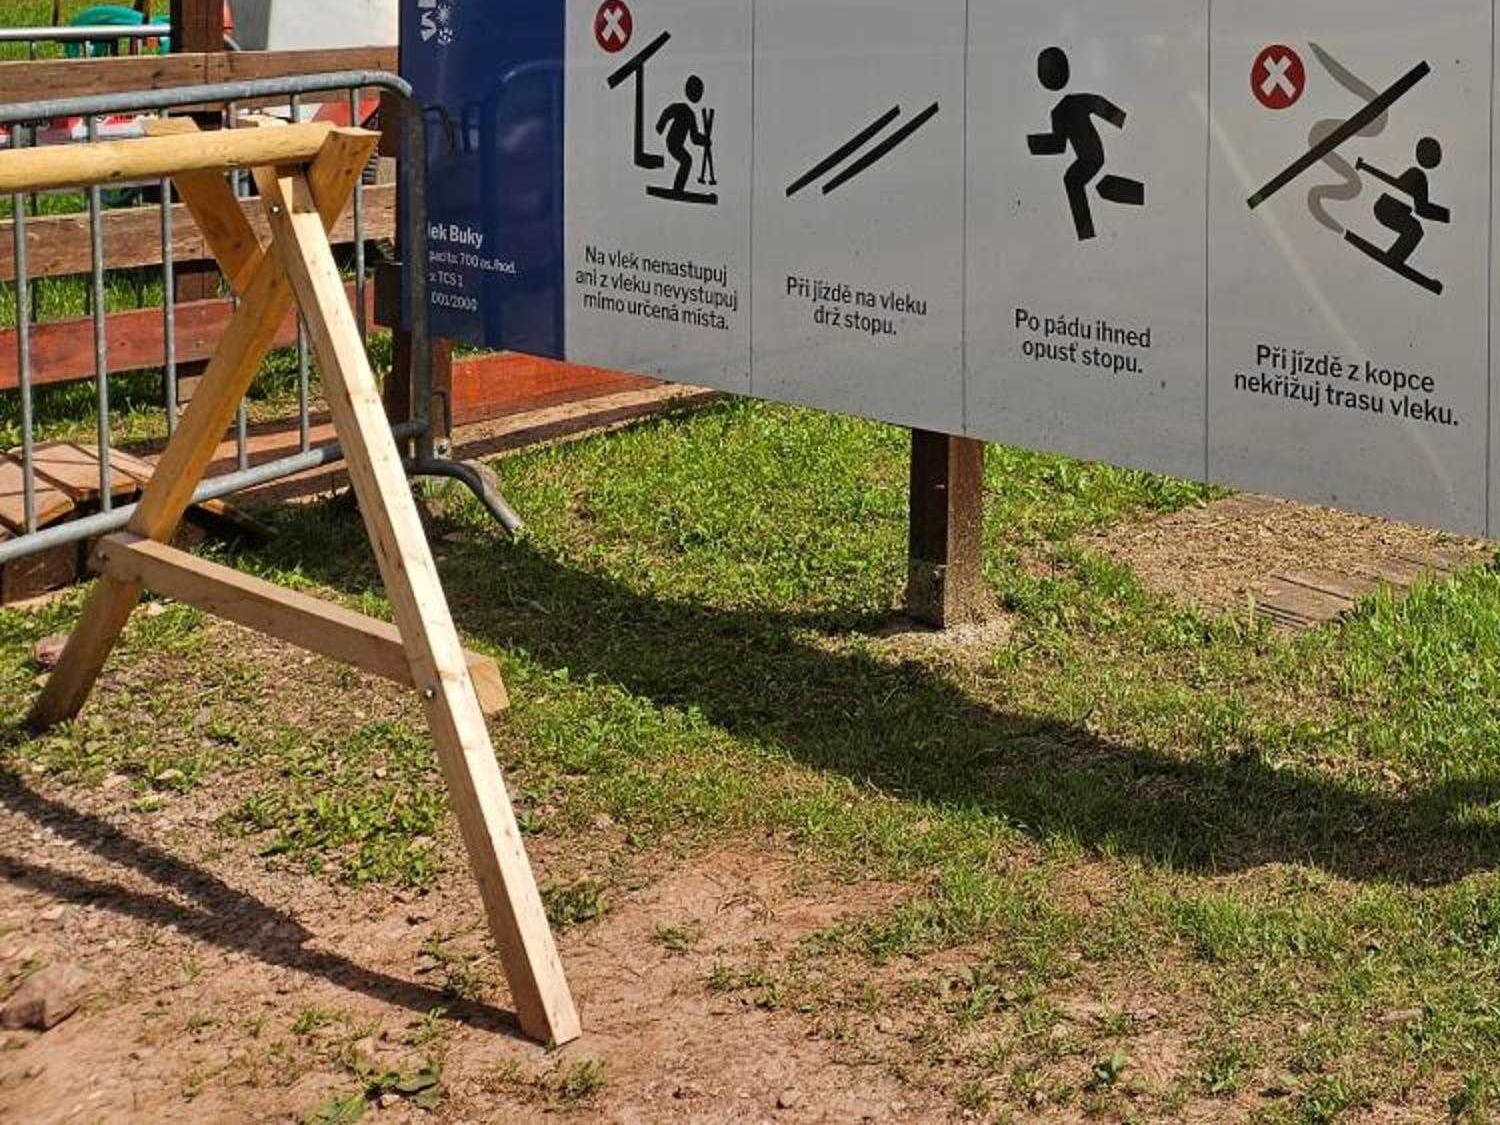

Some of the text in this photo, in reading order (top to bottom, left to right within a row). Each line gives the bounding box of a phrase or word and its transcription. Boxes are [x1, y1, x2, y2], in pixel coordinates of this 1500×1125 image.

[427, 221, 483, 250] lek Buky
[459, 252, 479, 268] 700
[585, 246, 728, 287] Na vlek nenastupuj
[575, 268, 738, 312] ani z vleku nevystupuj
[787, 276, 928, 316] Při jízdě na vleku
[583, 293, 730, 331] mimo určená místa.
[813, 305, 898, 336] drž stopu.
[1015, 308, 1152, 348] Po pádu ihned
[1022, 340, 1144, 375] opusť stopu.
[1256, 344, 1435, 393] Při jízdě z kopce
[1234, 372, 1460, 426] nekřižuj trasu vleku.
